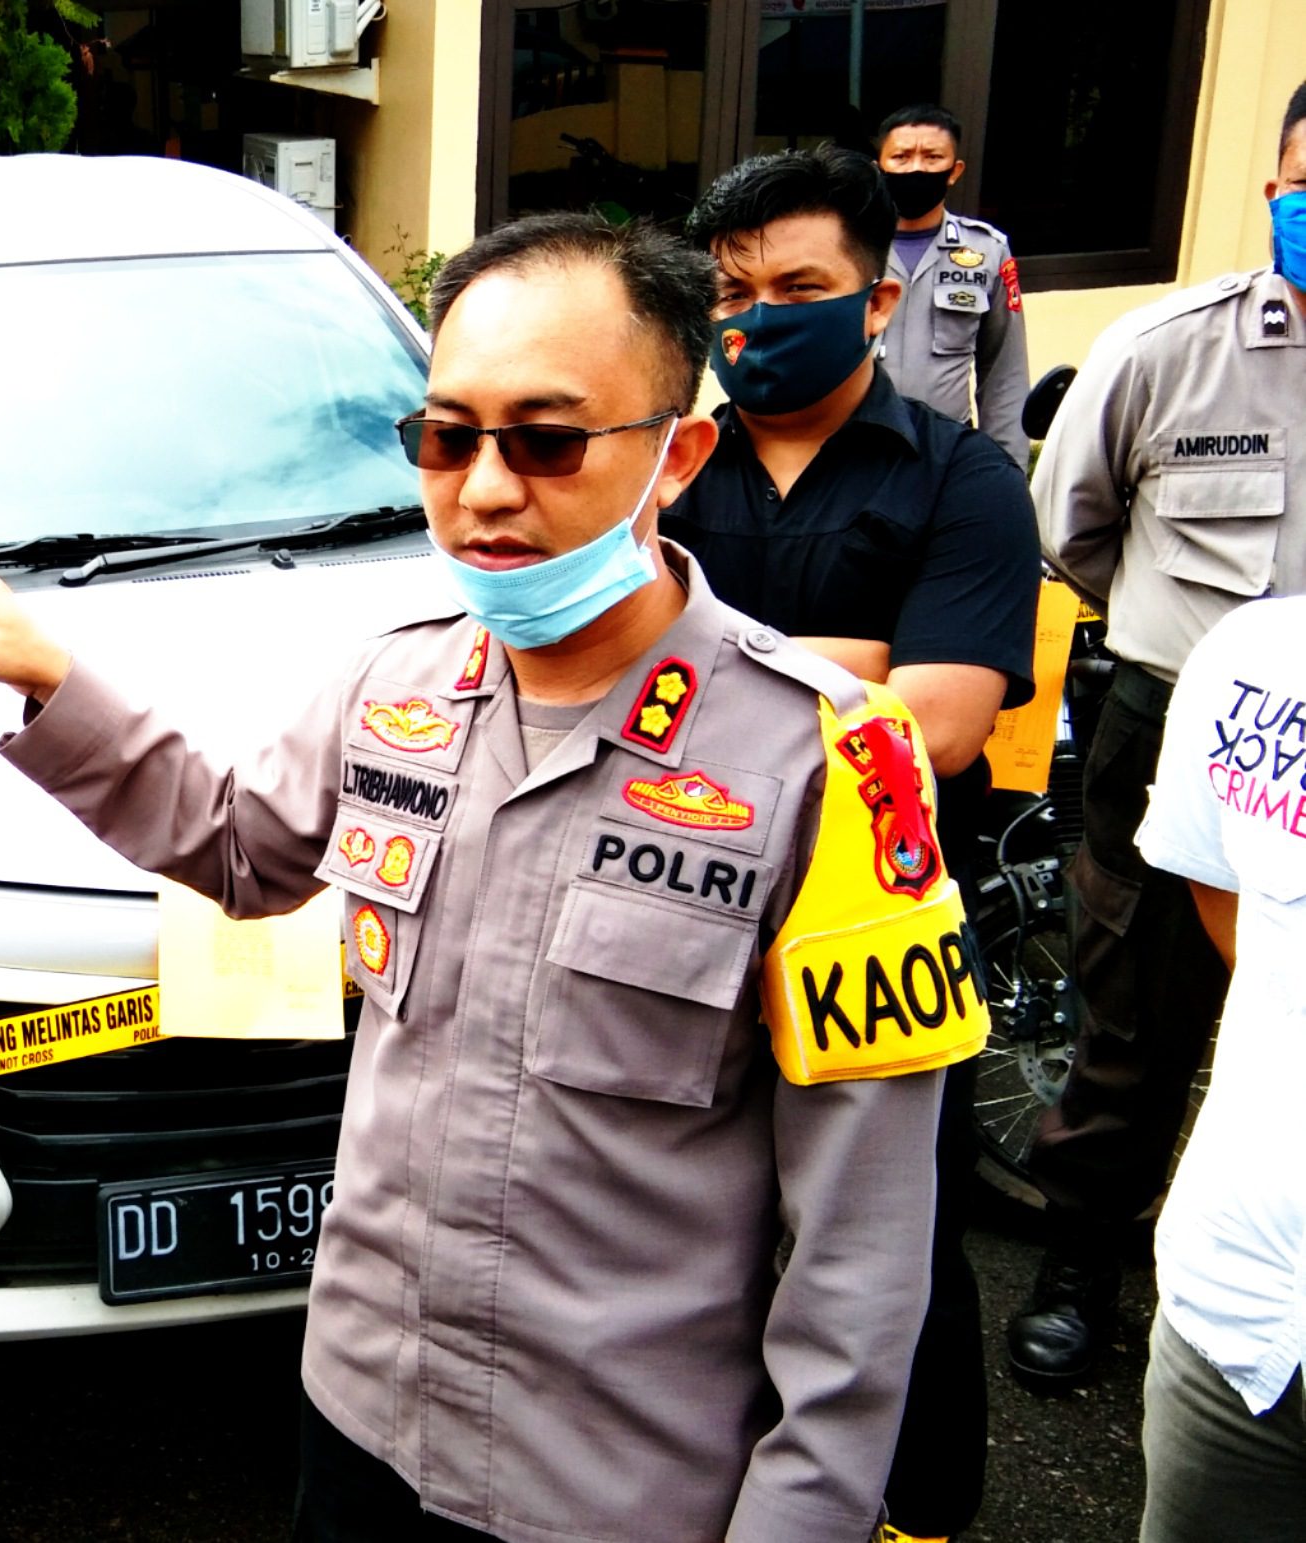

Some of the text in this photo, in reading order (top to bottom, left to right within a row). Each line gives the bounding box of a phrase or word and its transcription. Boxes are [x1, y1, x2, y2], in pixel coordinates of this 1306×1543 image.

[939, 271, 987, 285] POLRI
[1174, 434, 1269, 457] AMIRUDDIN
[1229, 679, 1306, 743] TUR
[592, 834, 756, 908] POLRI
[22, 1007, 101, 1049] MELINTAS
[106, 994, 154, 1029] GARIS
[134, 1025, 160, 1043] POLIC
[0, 1055, 19, 1072] NOT
[22, 1049, 55, 1067] CROSS
[117, 1201, 178, 1261] DD
